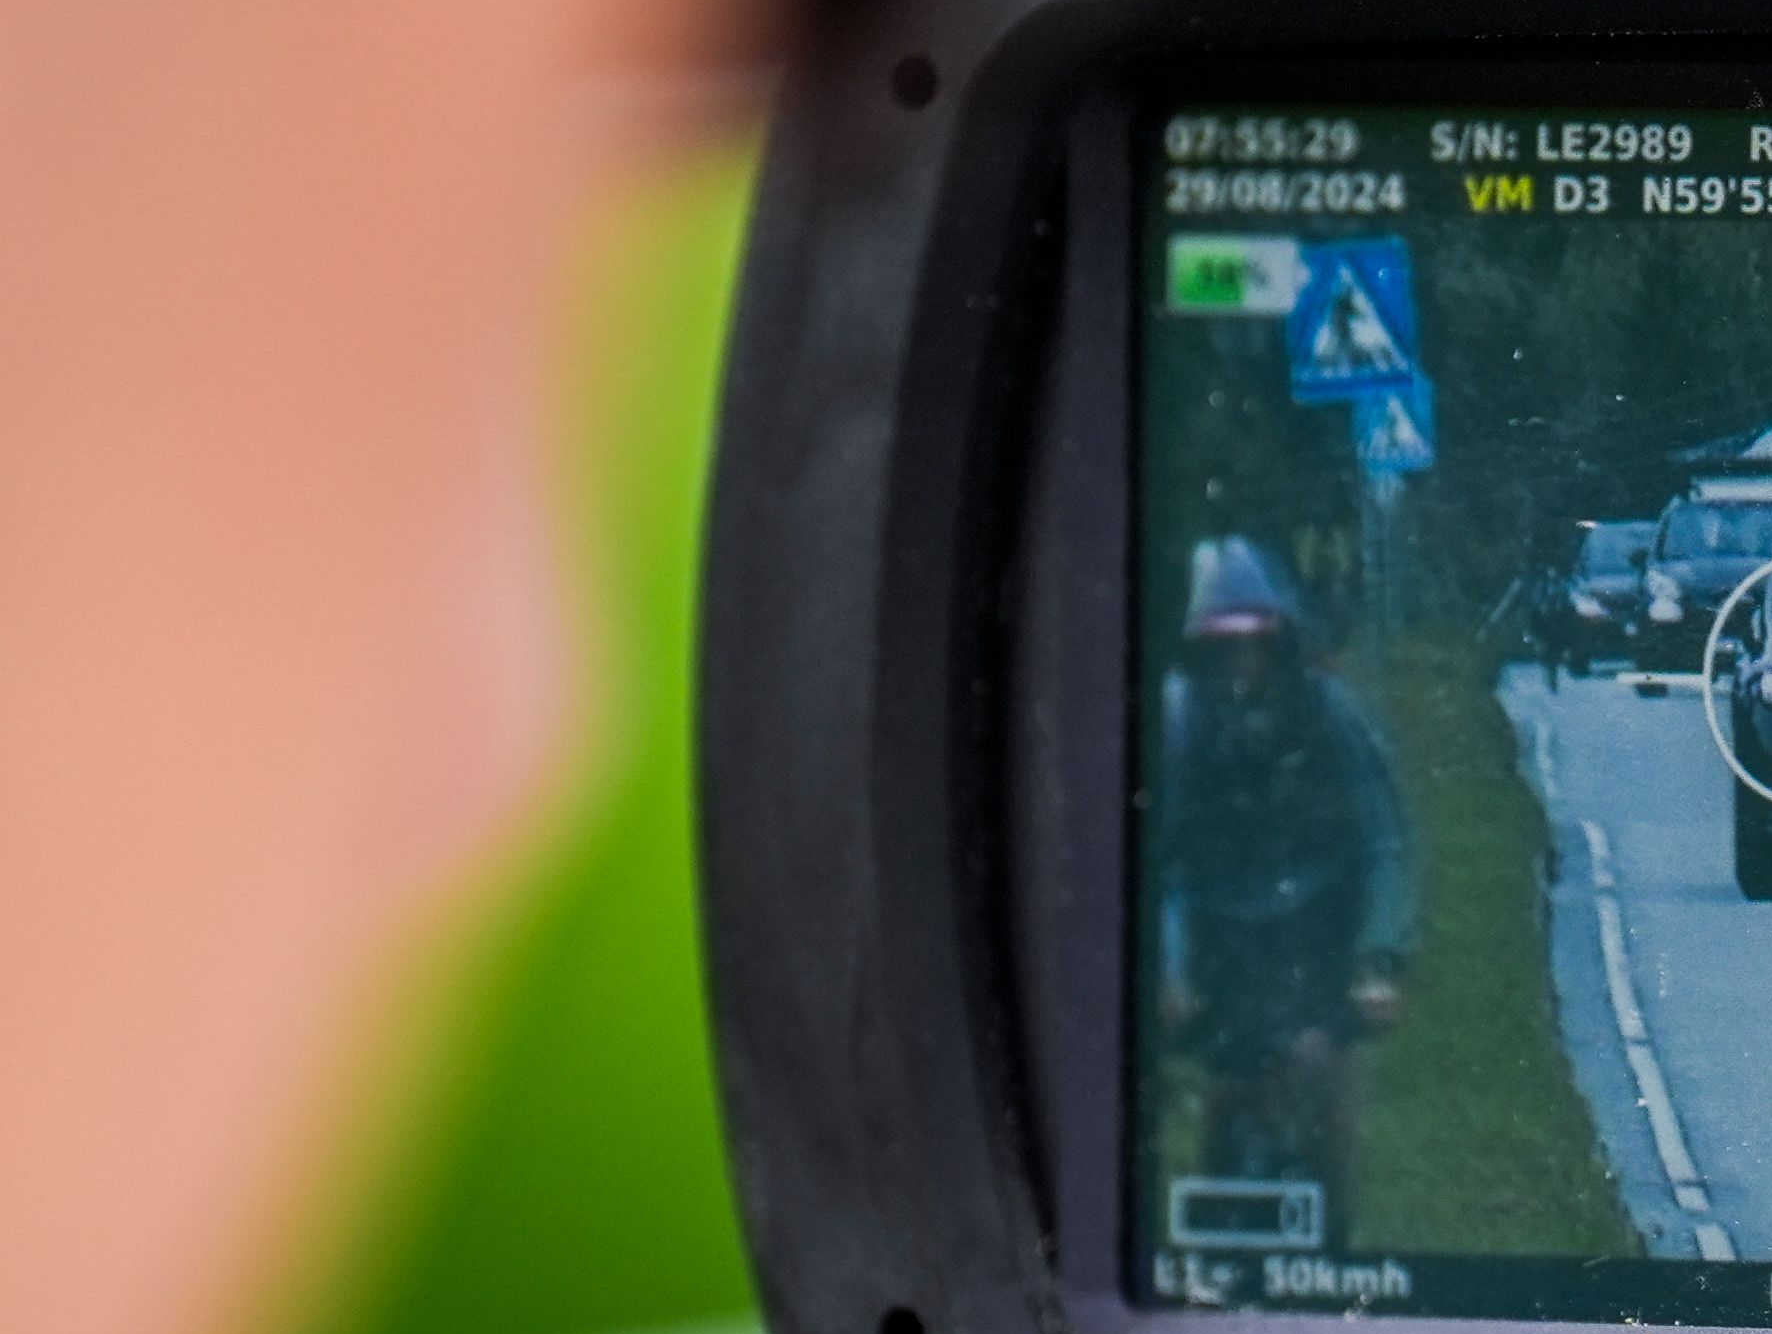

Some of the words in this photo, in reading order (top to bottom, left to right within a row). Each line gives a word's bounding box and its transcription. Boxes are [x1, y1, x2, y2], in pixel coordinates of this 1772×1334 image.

[1164, 117, 1360, 161] 07:55:29
[1429, 120, 1518, 161] S/N:
[1536, 124, 1693, 162] LE2989
[1164, 171, 1406, 213] 29/08/2024
[1463, 175, 1534, 213] VM
[1553, 176, 1610, 213] D3
